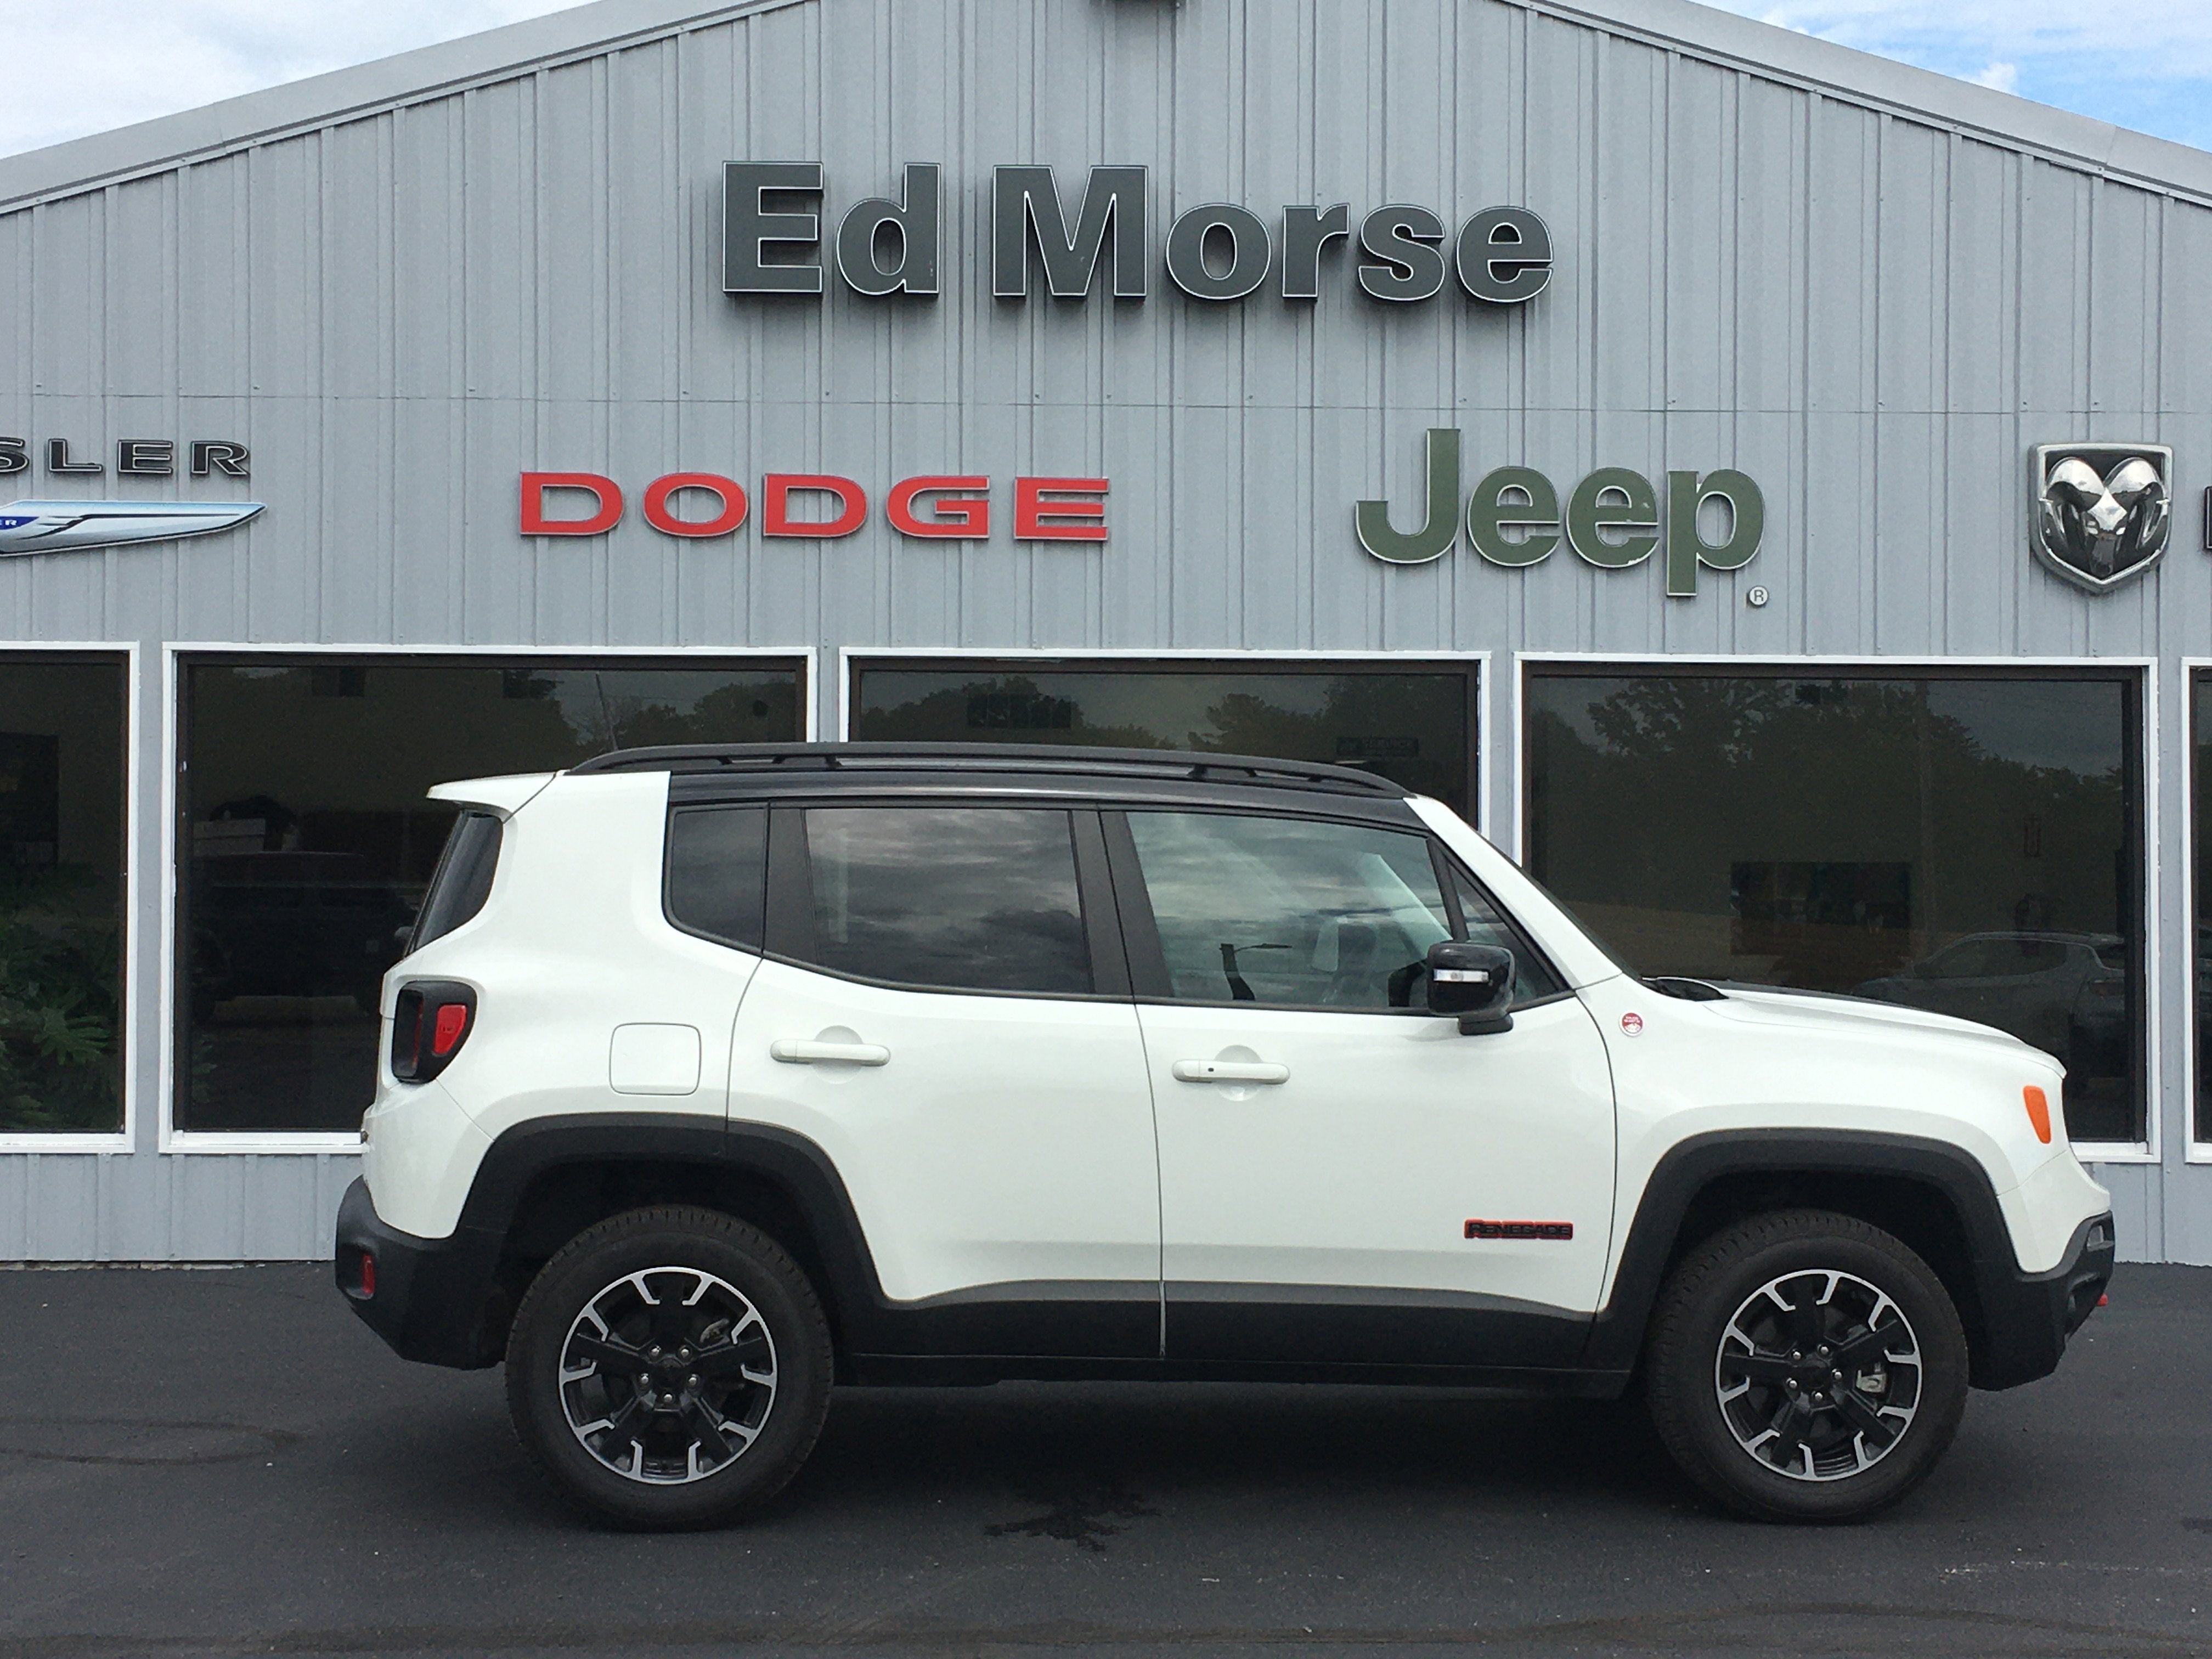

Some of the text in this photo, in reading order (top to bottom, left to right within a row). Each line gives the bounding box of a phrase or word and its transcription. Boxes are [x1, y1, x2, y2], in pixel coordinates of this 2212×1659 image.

[723, 161, 1553, 303] Ed Morse
[520, 472, 1109, 541] DODGE
[1356, 428, 1765, 596] Jeep
[1466, 1221, 1573, 1238] RENEGADE
